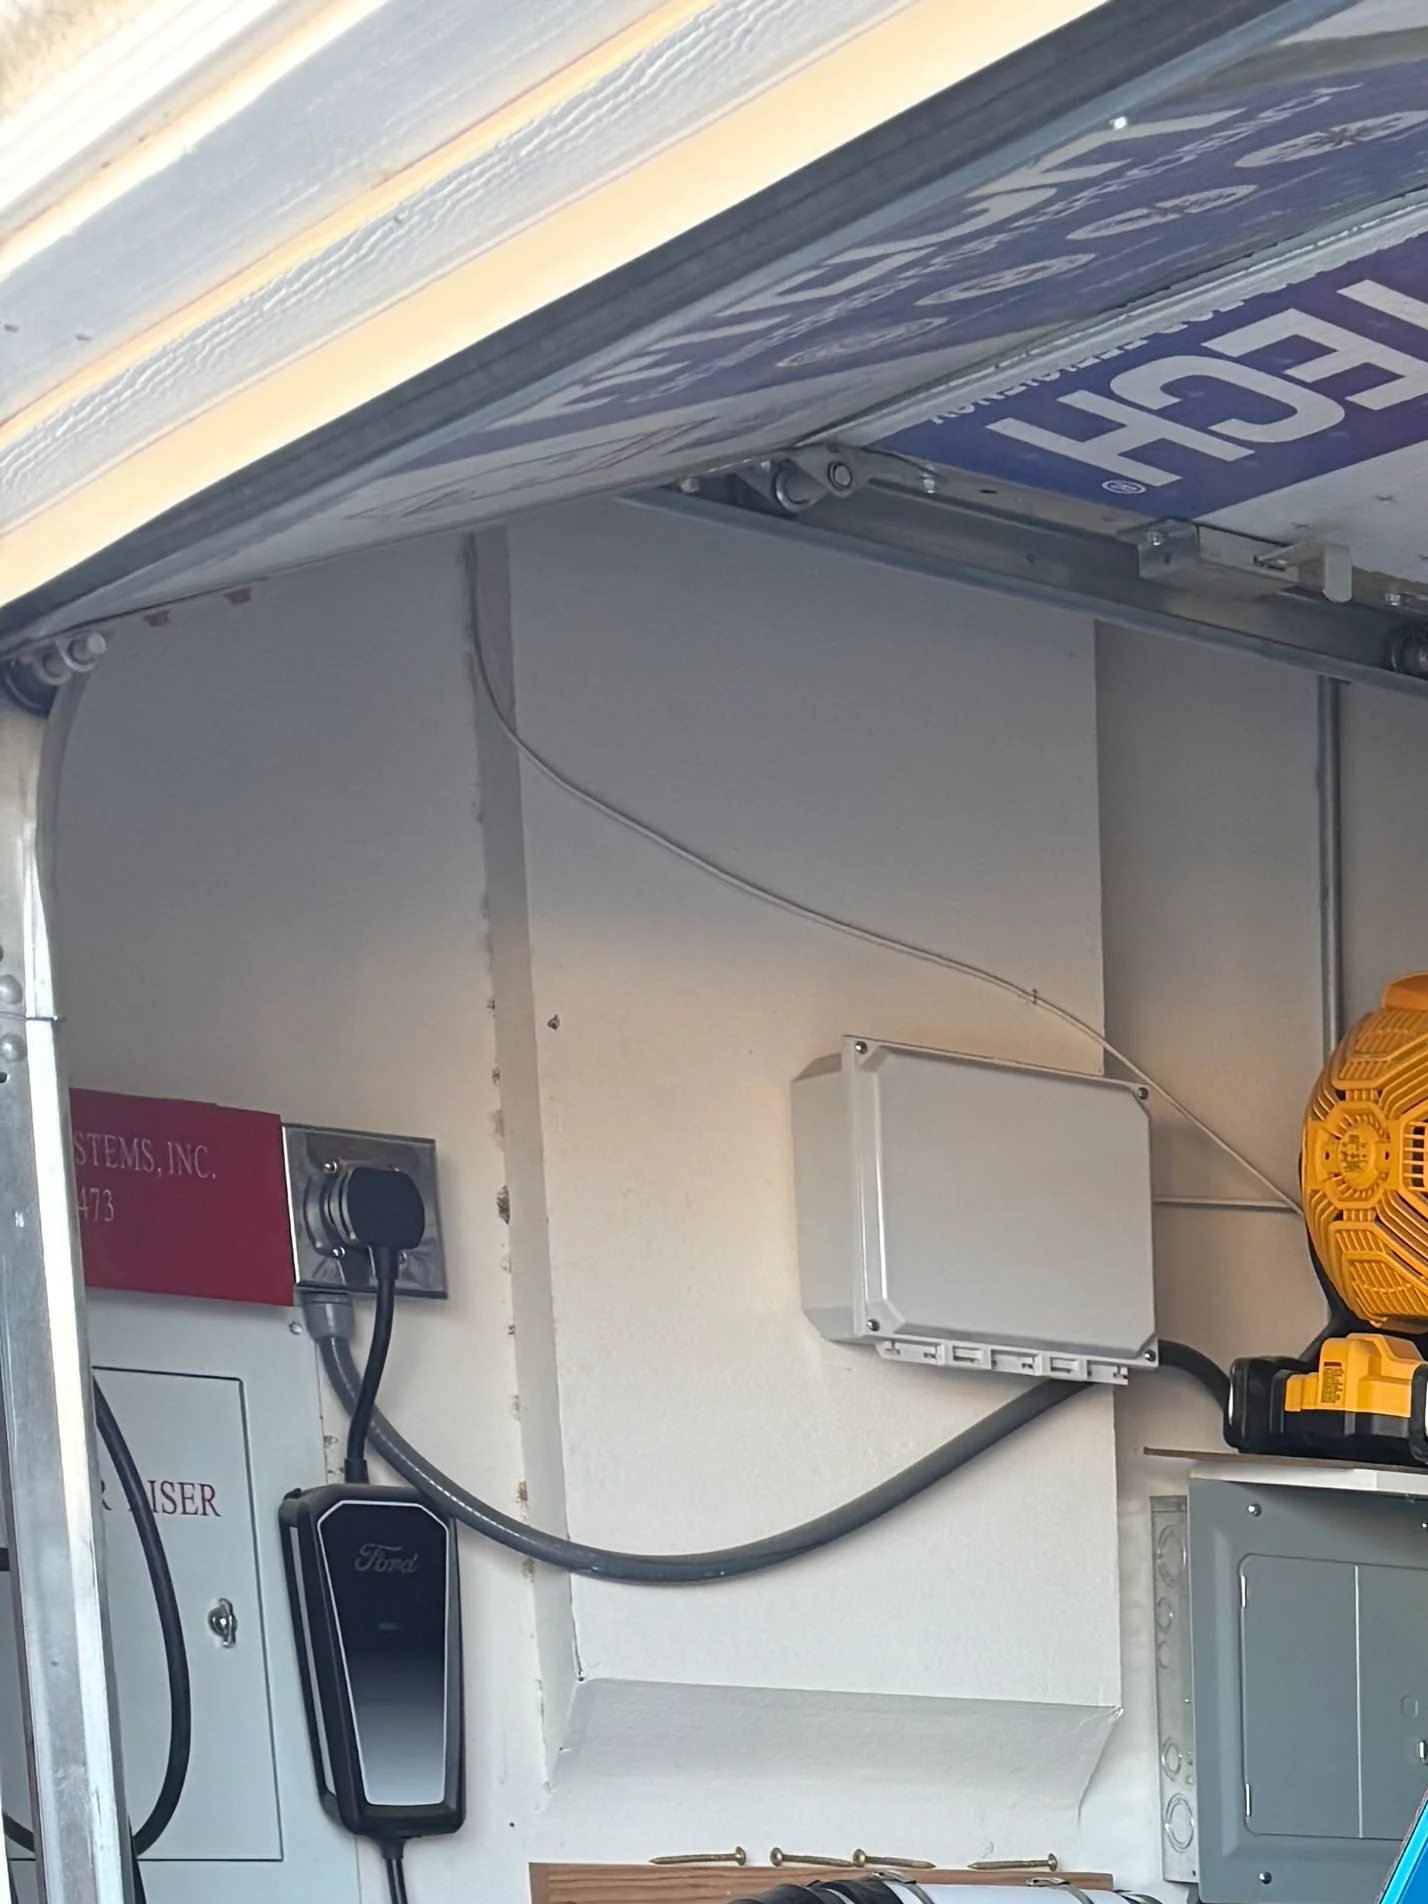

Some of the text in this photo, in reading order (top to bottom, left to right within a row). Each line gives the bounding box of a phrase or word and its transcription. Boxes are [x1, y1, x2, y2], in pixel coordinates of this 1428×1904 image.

[74, 1131, 217, 1179] STEMS, INC.
[77, 1187, 115, 1222] 473
[128, 1479, 222, 1517] ISER
[354, 1543, 420, 1574] Ford
